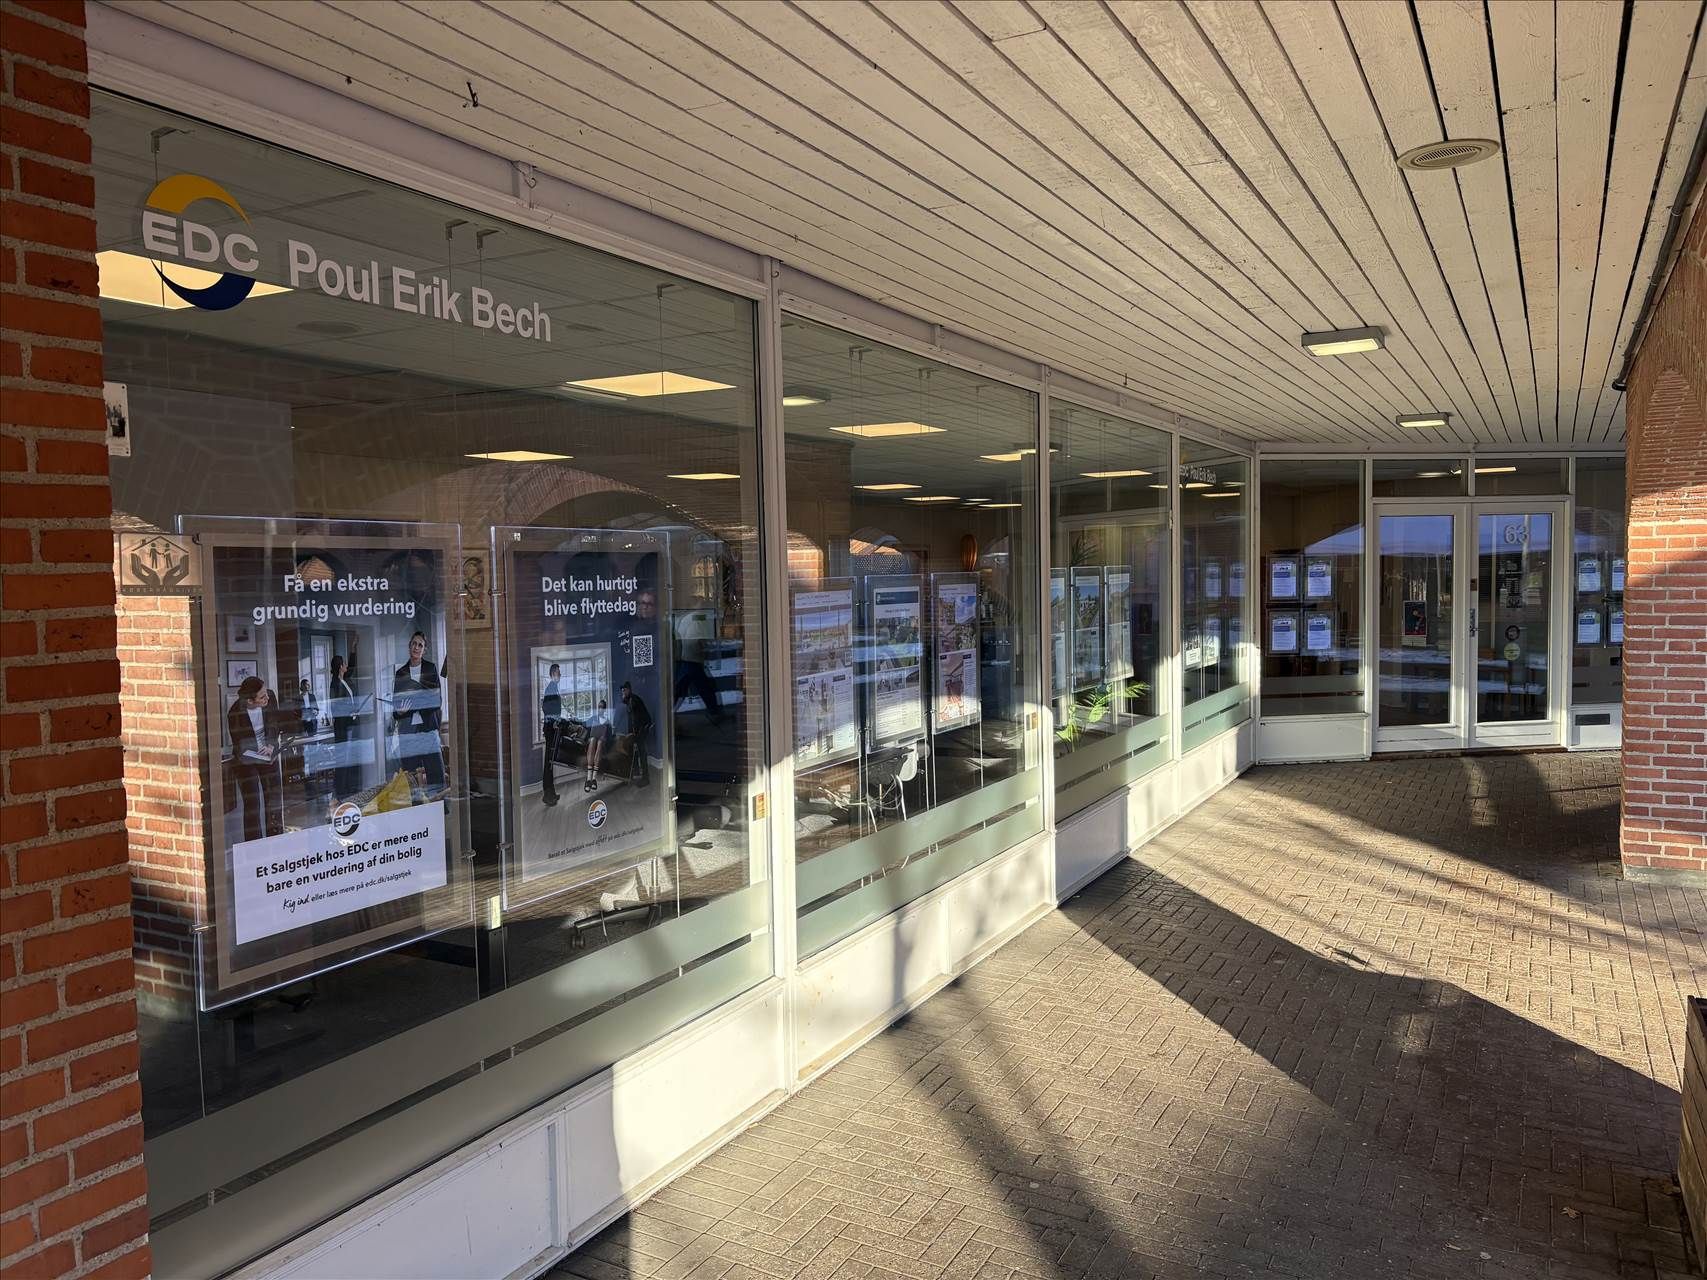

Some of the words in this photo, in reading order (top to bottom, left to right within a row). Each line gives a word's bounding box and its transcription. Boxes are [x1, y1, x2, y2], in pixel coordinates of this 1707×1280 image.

[142, 210, 259, 272] EDC
[288, 239, 380, 305] Poul
[392, 265, 462, 323] Erik
[472, 286, 551, 343] Bech
[1504, 525, 1529, 544] 63
[284, 573, 304, 592] Få
[310, 578, 332, 592] en
[337, 573, 389, 592] ekstra
[542, 577, 567, 593] Det
[570, 575, 593, 592] kan
[596, 575, 638, 594] hurtigt
[253, 600, 329, 625] grundig
[333, 598, 416, 618] vurdering
[544, 598, 578, 616] blive
[580, 597, 637, 618] flyttedag
[333, 812, 361, 828] EDC
[589, 808, 606, 820] EDC
[256, 865, 269, 878] Et
[271, 852, 324, 875] Salgstjek
[326, 849, 345, 862] hos
[347, 842, 370, 856] EDC
[371, 840, 382, 850] er
[383, 834, 409, 848] mere
[410, 827, 429, 842] end
[266, 880, 293, 894] bare
[295, 875, 310, 886] en
[312, 861, 365, 882] vurdering
[366, 855, 378, 868] af
[379, 850, 395, 864] din
[397, 846, 422, 863] bolig
[283, 897, 297, 913] Kig
[297, 893, 311, 906] ind
[311, 892, 326, 902] eller
[326, 889, 338, 898] læs
[338, 885, 355, 895] mere
[355, 882, 365, 892] på
[365, 868, 413, 888] edc.dk/salgstjek
